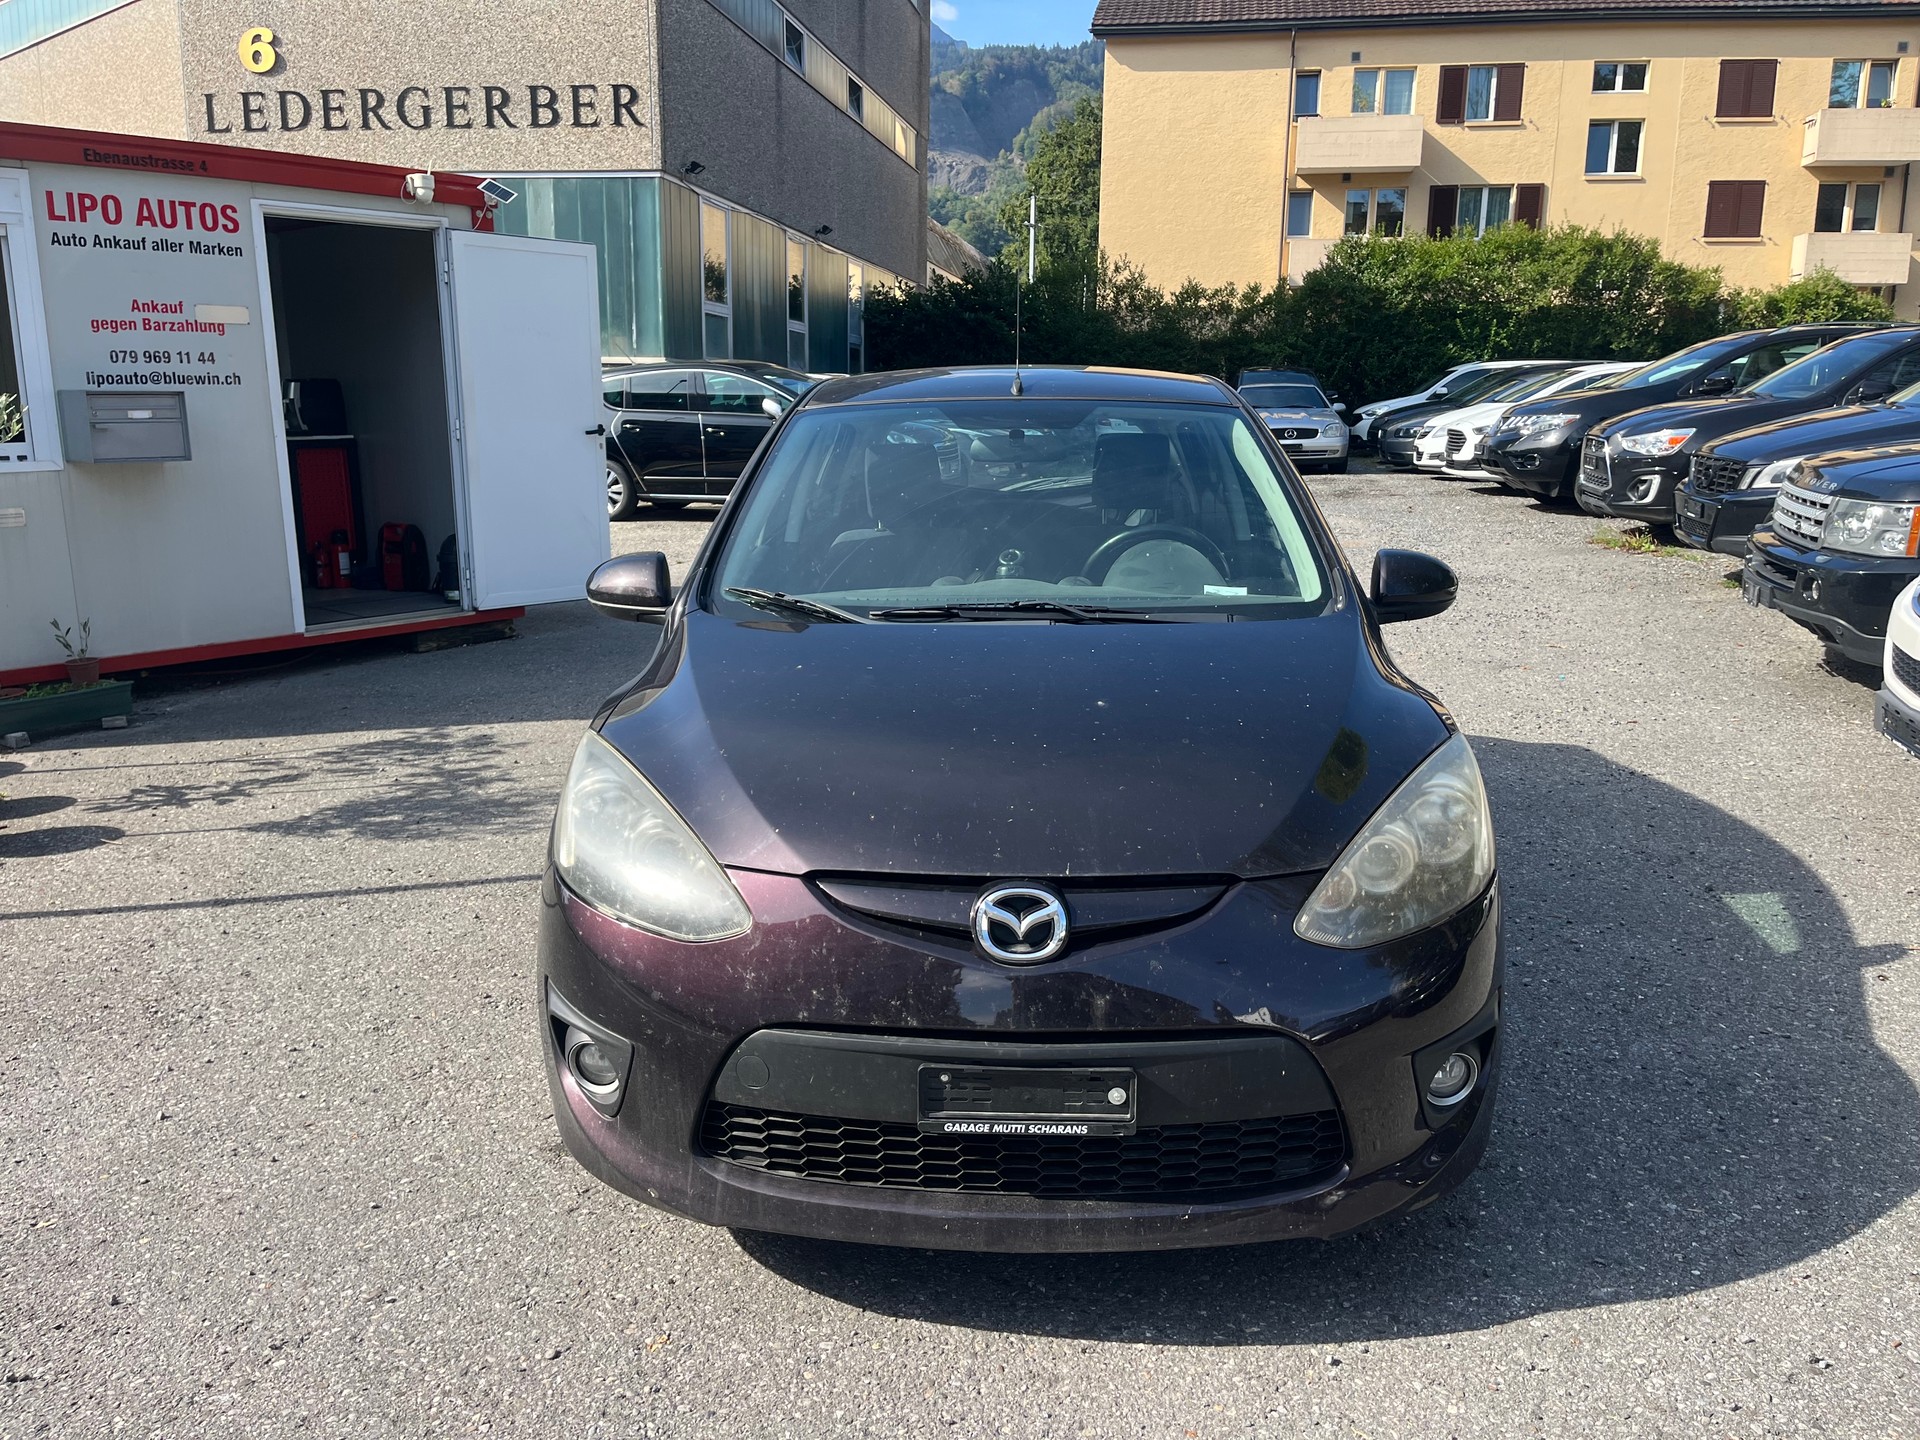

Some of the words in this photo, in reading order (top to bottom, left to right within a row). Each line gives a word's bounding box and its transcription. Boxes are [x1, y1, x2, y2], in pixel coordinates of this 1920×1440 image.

[238, 27, 276, 73] 6
[202, 83, 646, 133] LEDERGERBER
[83, 147, 194, 172] Ebenaustrasse
[199, 160, 208, 172] 4
[45, 190, 123, 226] LIPO
[136, 197, 240, 234] AUTOS
[51, 231, 87, 248] Auto
[92, 234, 147, 251] Ankauf
[151, 238, 184, 253] aller
[189, 240, 243, 257] Marken
[131, 299, 184, 314] Ankauf
[90, 318, 137, 333] gegen
[142, 317, 225, 336] Barzahlung
[109, 350, 139, 364] 079
[143, 350, 171, 364] 969
[176, 351, 191, 364] 11
[197, 351, 216, 364] 44
[86, 371, 242, 388] lipoauto@bluewin.ch
[943, 1123, 990, 1133] GARAGE
[992, 1124, 1025, 1133] MUTTI
[1027, 1124, 1088, 1134] SCHARANS
